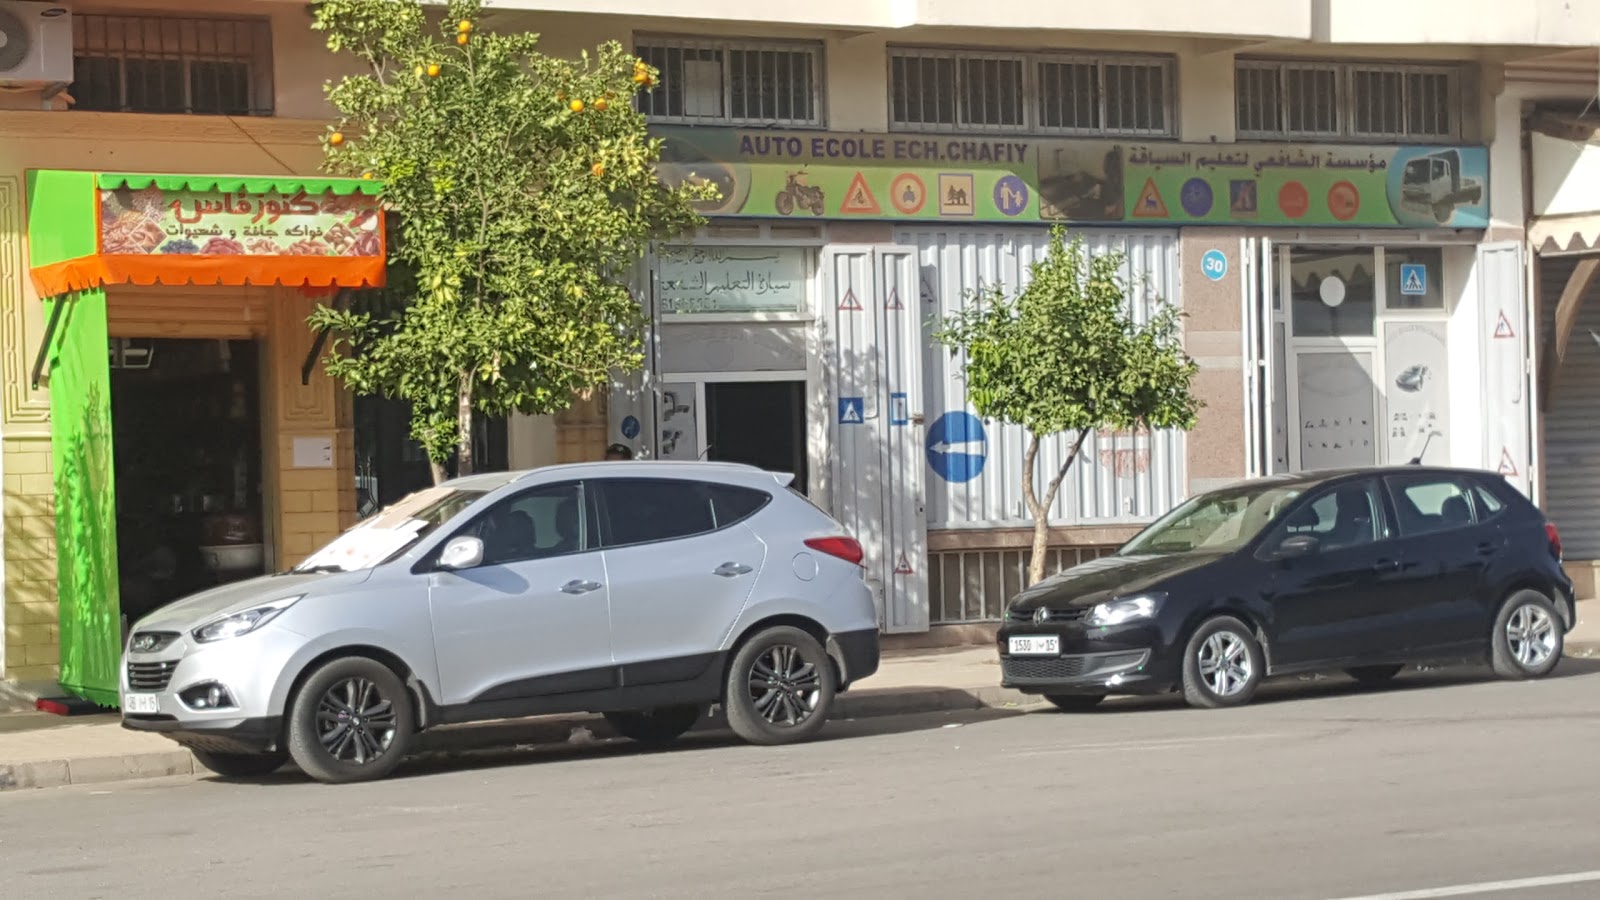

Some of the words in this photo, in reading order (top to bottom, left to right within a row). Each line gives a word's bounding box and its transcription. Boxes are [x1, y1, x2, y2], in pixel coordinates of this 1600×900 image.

[739, 135, 803, 157] AUTO
[811, 138, 886, 159] ECOLE
[894, 140, 1028, 163] ECH.CHAFIY
[1129, 147, 1190, 170] السياقة
[1195, 152, 1248, 170] لتعليم
[1254, 149, 1320, 177] الشافعي
[1325, 152, 1387, 173] مؤسسة
[168, 191, 251, 224] فاس
[251, 190, 319, 224] كنوز
[229, 229, 236, 240] و
[243, 225, 278, 239] جافة
[285, 225, 323, 240] فواكه
[1205, 257, 1223, 273] 30
[755, 271, 791, 295] سيارة
